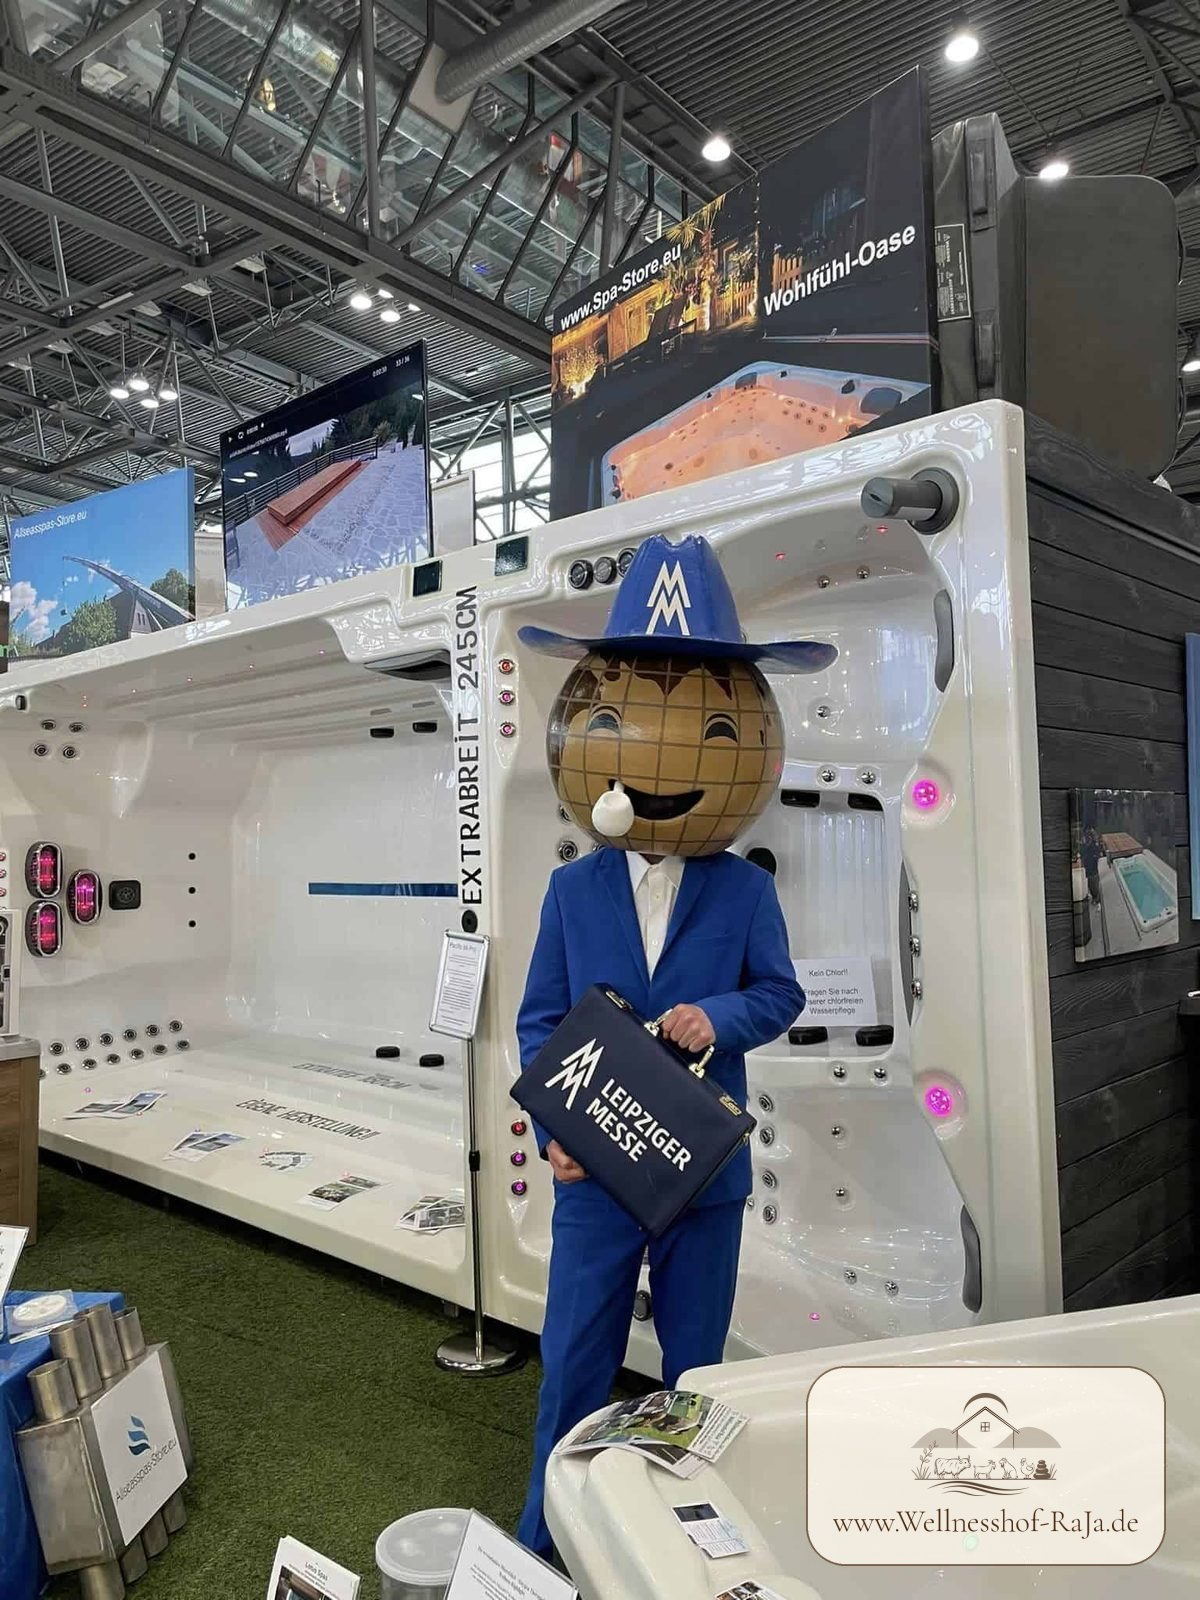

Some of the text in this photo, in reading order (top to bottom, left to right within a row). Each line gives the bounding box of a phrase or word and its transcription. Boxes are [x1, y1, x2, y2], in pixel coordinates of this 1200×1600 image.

[560, 243, 681, 331] www.Spa-Store.eu
[763, 225, 916, 316] Wohlfühl-Oase
[456, 585, 479, 690] 245CM
[808, 969, 824, 977] Kein
[809, 1006, 855, 1015] Wasserpflege
[842, 987, 858, 995] nach
[585, 1098, 647, 1162] MESSE
[601, 1078, 692, 1171] LEIPZIGER
